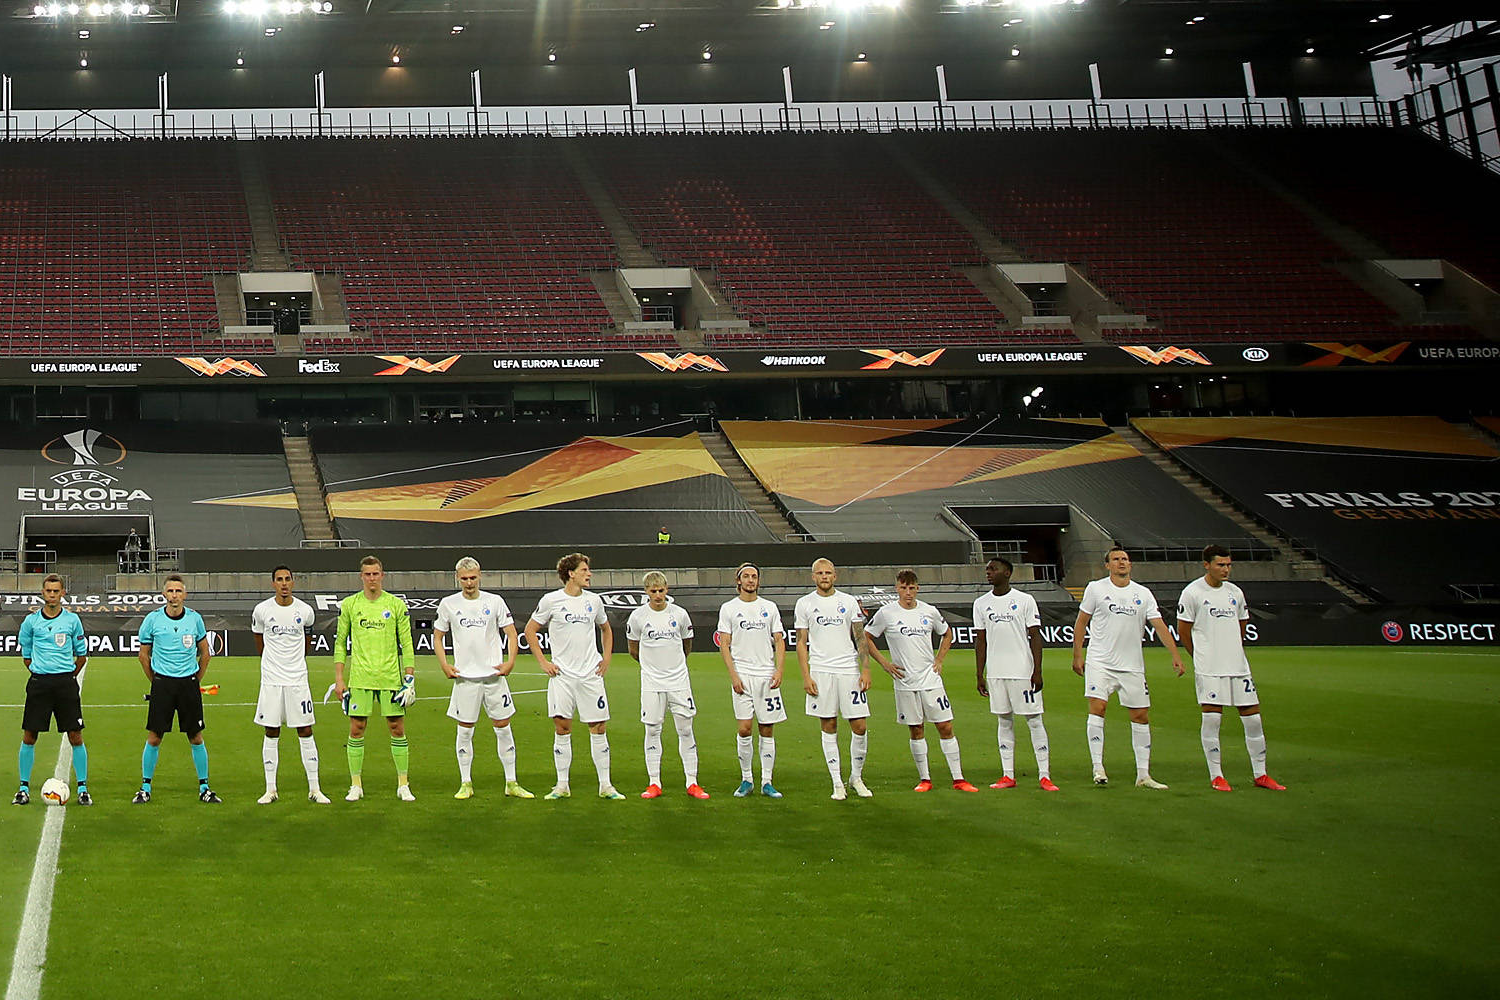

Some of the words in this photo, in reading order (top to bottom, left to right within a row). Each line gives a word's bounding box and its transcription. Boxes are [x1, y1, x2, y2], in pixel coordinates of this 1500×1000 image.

[977, 353, 1004, 362] UEFA
[1005, 353, 1043, 362] EUROPA
[1045, 352, 1083, 361] LEAGUE
[1419, 348, 1455, 358] UEFA
[1456, 348, 1500, 358] EUROP
[31, 364, 57, 373] UEFA
[59, 364, 98, 373] EUROPA
[99, 363, 138, 372] LEAGUE
[298, 359, 341, 373] FedEx
[493, 360, 520, 369] UEFA
[521, 360, 560, 368] EUROPA
[562, 359, 600, 368] LEAGUE
[53, 471, 113, 487] UEFA
[17, 487, 153, 502] EUROPA
[1263, 492, 1435, 508] FINALS
[41, 502, 128, 511] LEAGUE
[1332, 508, 1500, 521] GERMAN
[107, 595, 167, 605] 2020
[1108, 603, 1137, 615] Carlsberg
[1209, 606, 1236, 618] Carlsberg
[459, 617, 486, 628] Carlsberg
[565, 613, 591, 624] Carlsberg
[816, 615, 844, 626] Carlsberg
[988, 612, 1014, 623] Carlsberg
[359, 618, 386, 629] Carlsberg
[739, 619, 766, 630] Carlsberg
[272, 625, 299, 636] Carlsberg
[648, 629, 675, 640] Carlsberg
[900, 626, 928, 637] Carlsberg
[1409, 622, 1496, 641] RESPECT
[597, 695, 605, 710] 6
[850, 690, 867, 706] 20
[936, 695, 950, 711] 16
[301, 700, 313, 715] 10
[765, 696, 782, 712] 33
